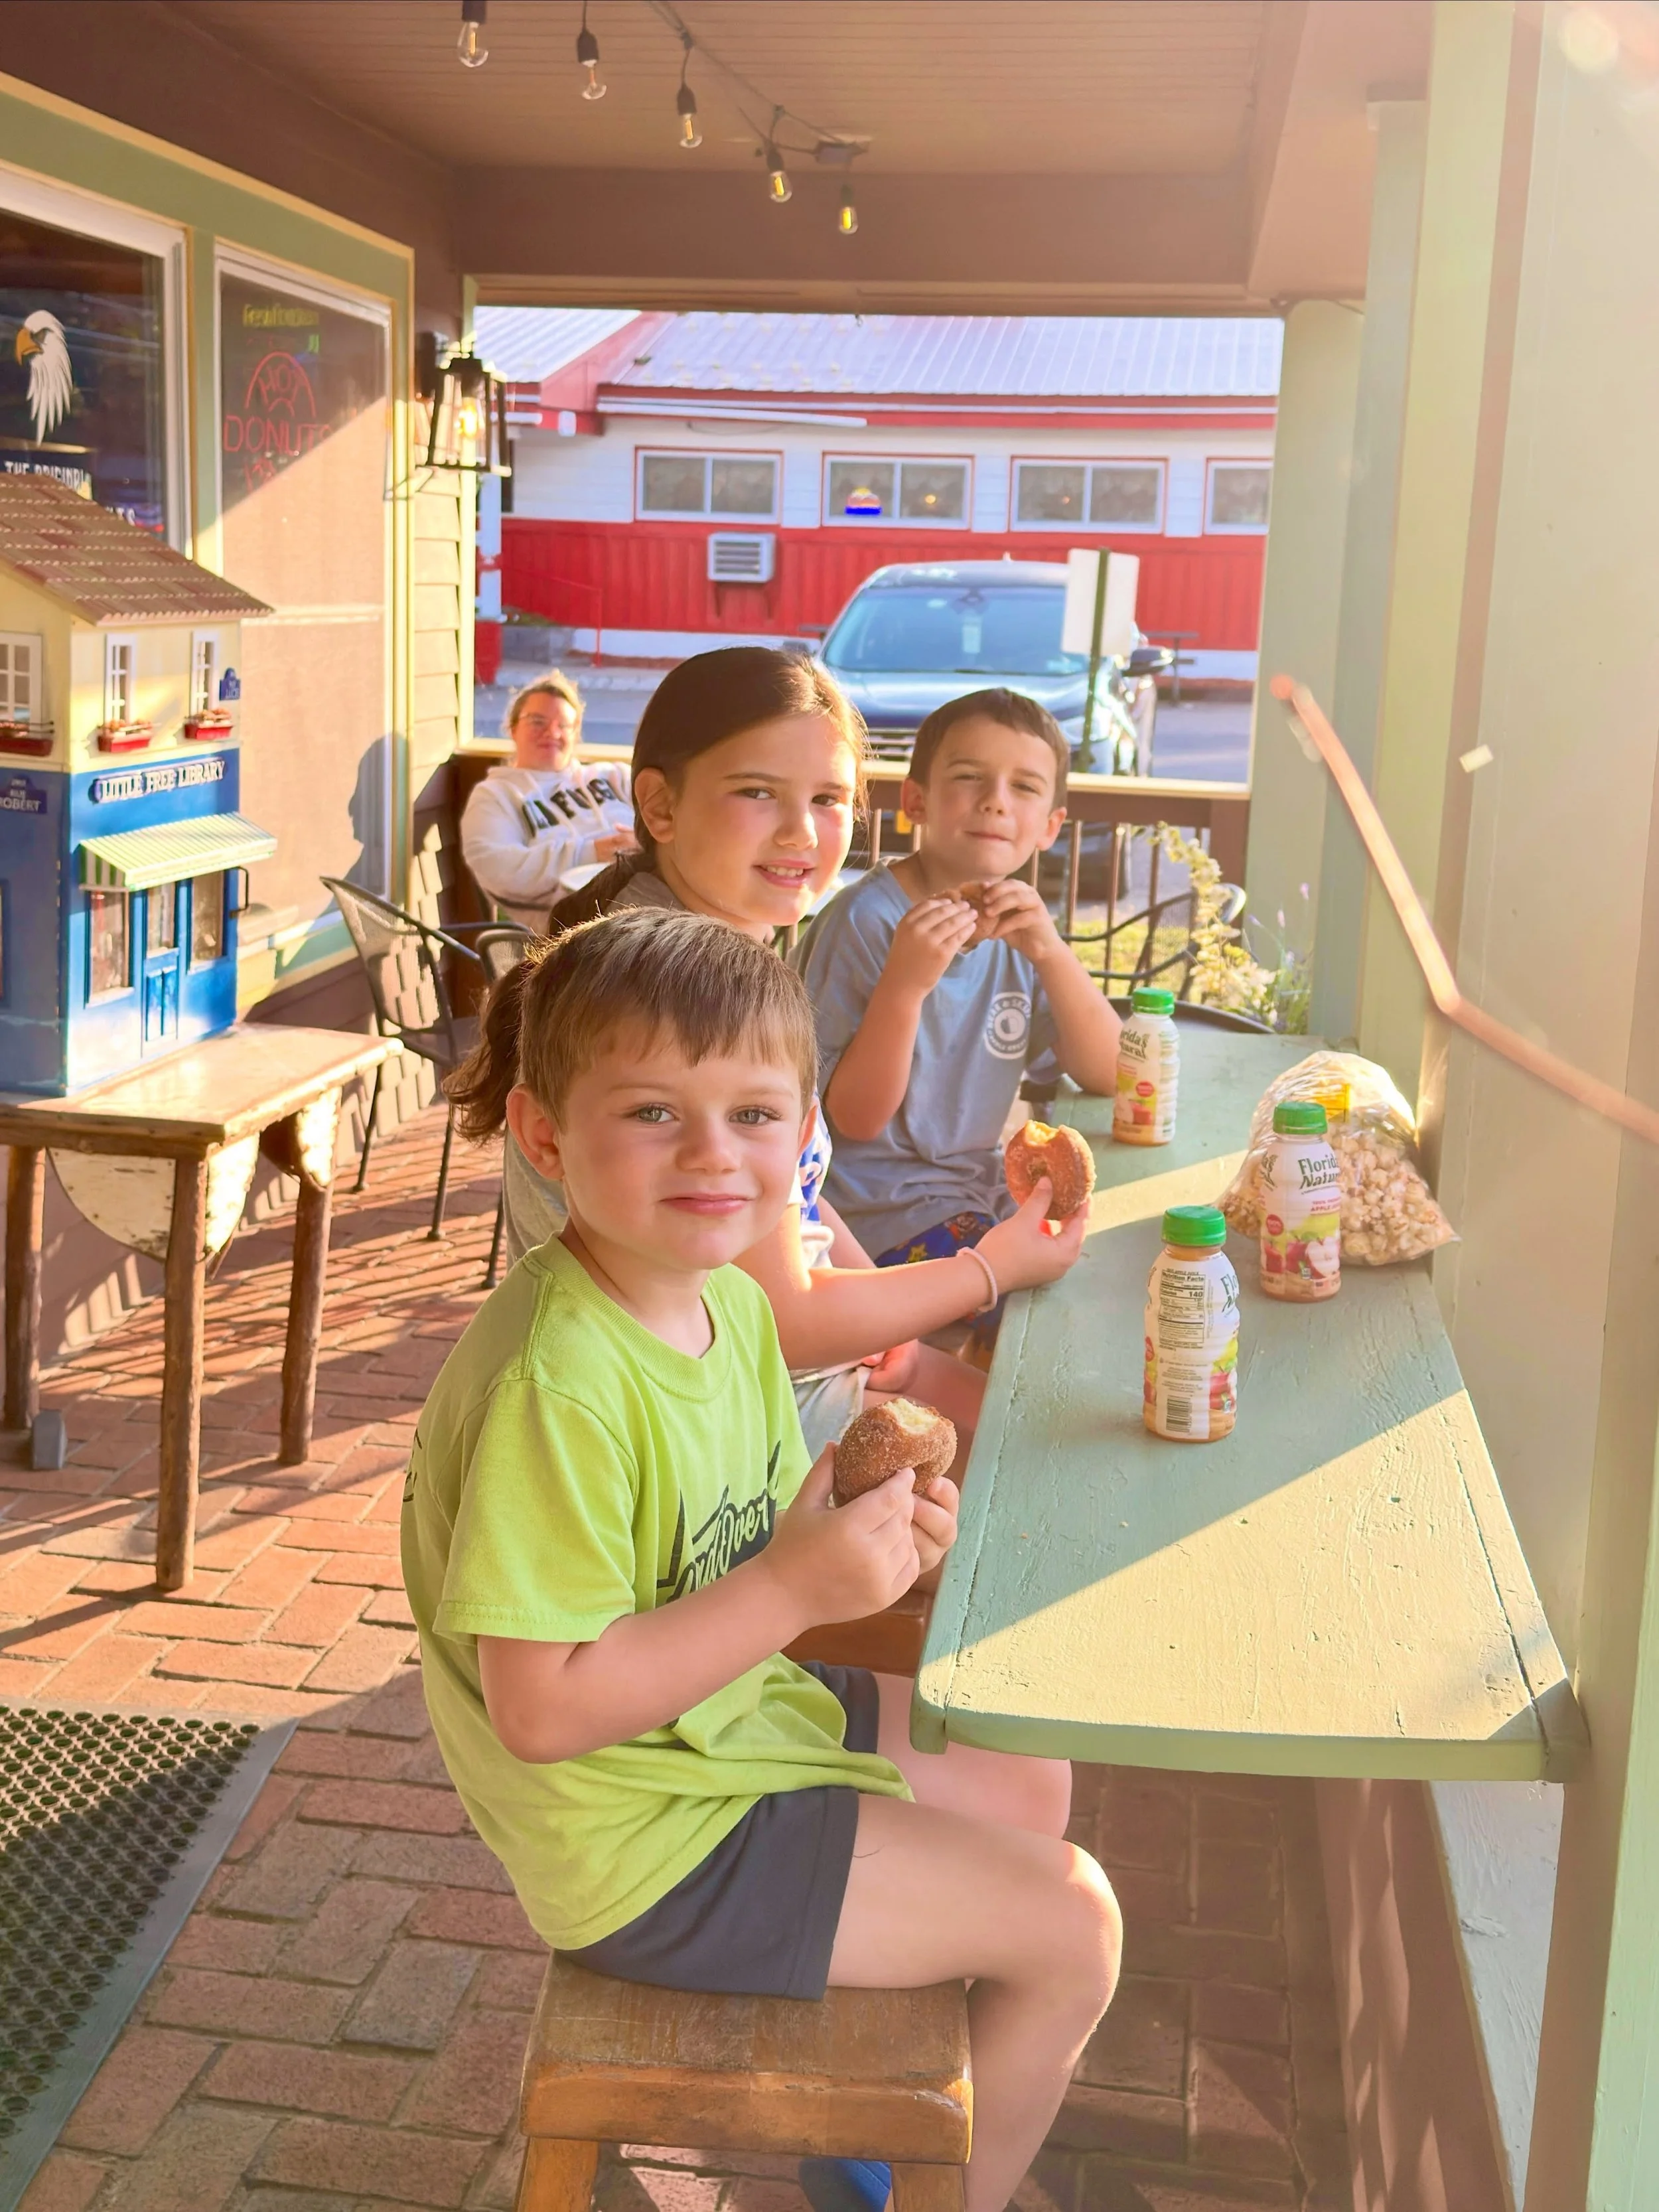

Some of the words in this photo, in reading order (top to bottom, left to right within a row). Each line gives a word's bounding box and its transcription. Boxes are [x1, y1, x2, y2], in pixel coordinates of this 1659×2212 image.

[102, 773, 144, 799] LITTLE
[145, 770, 177, 793] FREE
[178, 761, 225, 787] LIBRARY
